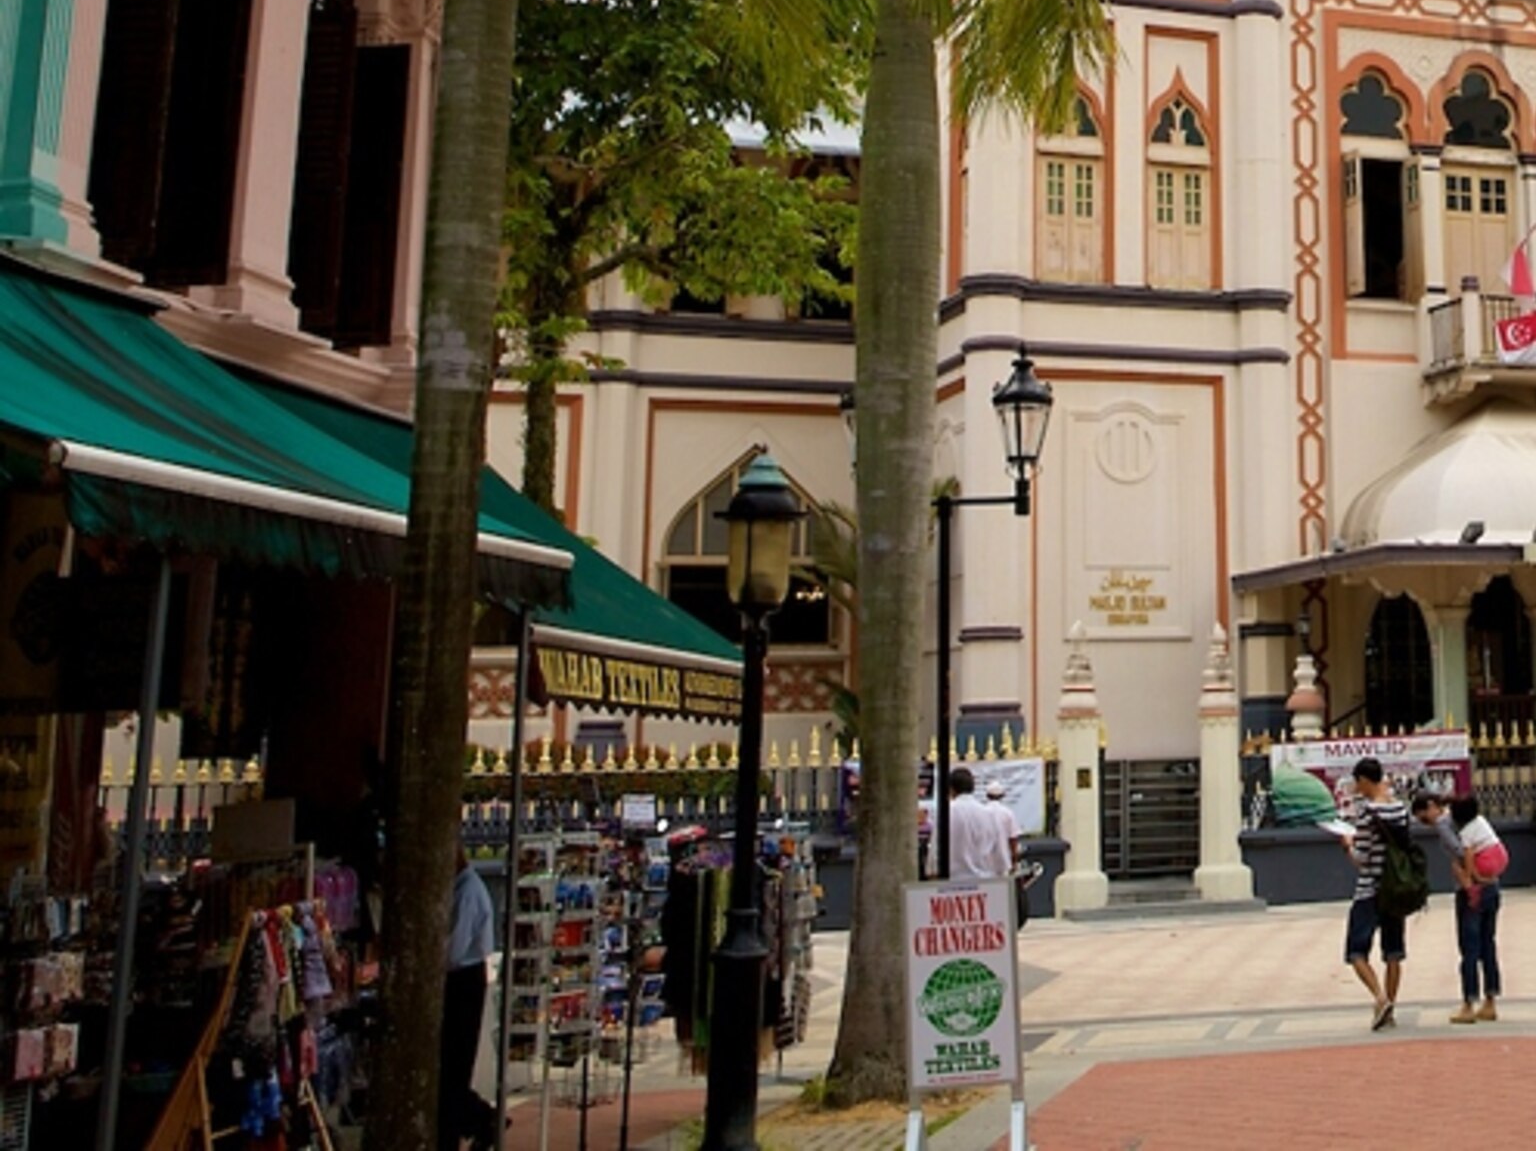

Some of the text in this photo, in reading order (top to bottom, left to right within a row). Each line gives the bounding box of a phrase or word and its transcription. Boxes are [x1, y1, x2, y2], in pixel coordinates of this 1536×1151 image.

[536, 648, 603, 699] WAHAB
[605, 659, 680, 709] TEXTILES
[1324, 741, 1407, 758] MAWLID
[929, 893, 988, 924] MONEY
[914, 922, 1006, 956] CHANGERS
[924, 1055, 1001, 1075] TEXTILES
